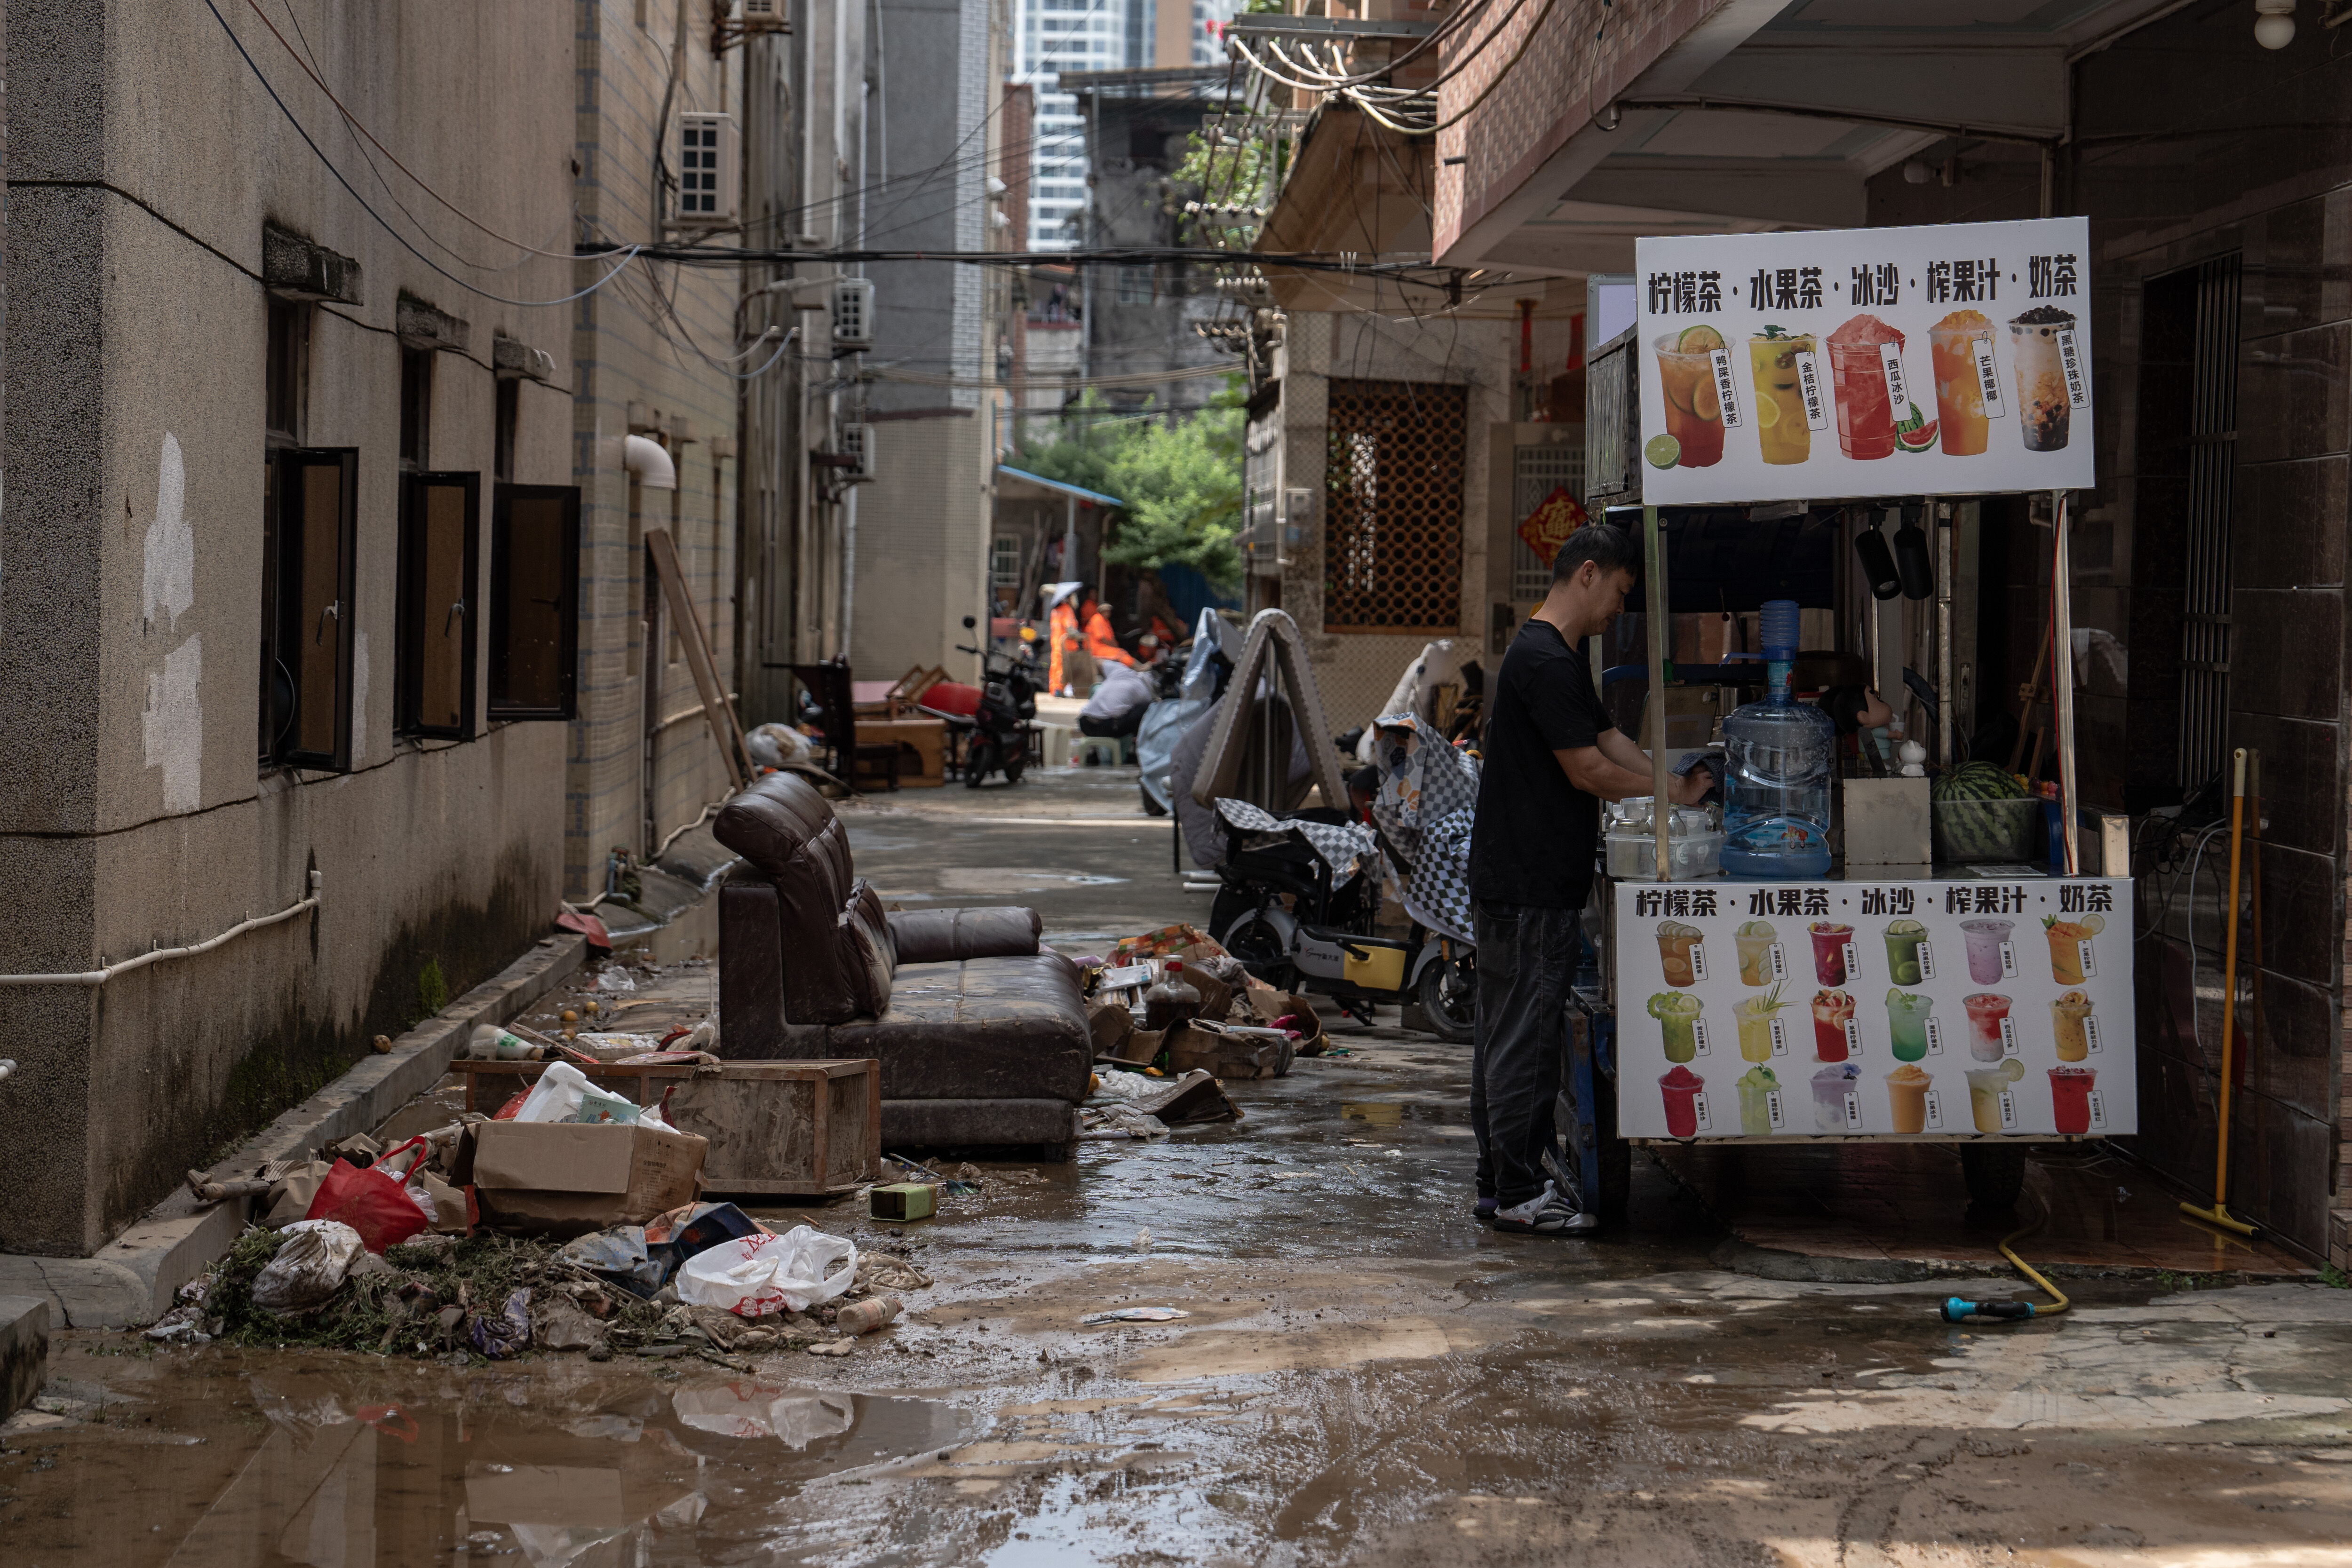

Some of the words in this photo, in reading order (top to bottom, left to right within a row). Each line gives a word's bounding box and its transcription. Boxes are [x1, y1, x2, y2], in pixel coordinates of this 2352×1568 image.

[1648, 271, 1721, 314] 柠檬茶
[1750, 267, 1822, 311] 水果茶
[1851, 263, 1899, 306] 冰沙
[1927, 258, 2000, 303] 榨果汁
[2029, 254, 2076, 298] 奶茶
[1716, 355, 1737, 424] 鸭屎香柠檬茶
[1802, 362, 1820, 419] 金桔柠檬茶
[1887, 359, 1904, 404] 西瓜冰沙
[1980, 356, 1997, 402] 芒果椰椰
[2061, 335, 2084, 403] 黑糖珍珠奶茶
[1636, 889, 1716, 917] 柠檬茶
[1749, 888, 1829, 916] 水果茶
[1862, 887, 1915, 915] 冰沙
[1946, 886, 2027, 914] 榨果汁
[2059, 885, 2112, 912] 奶茶
